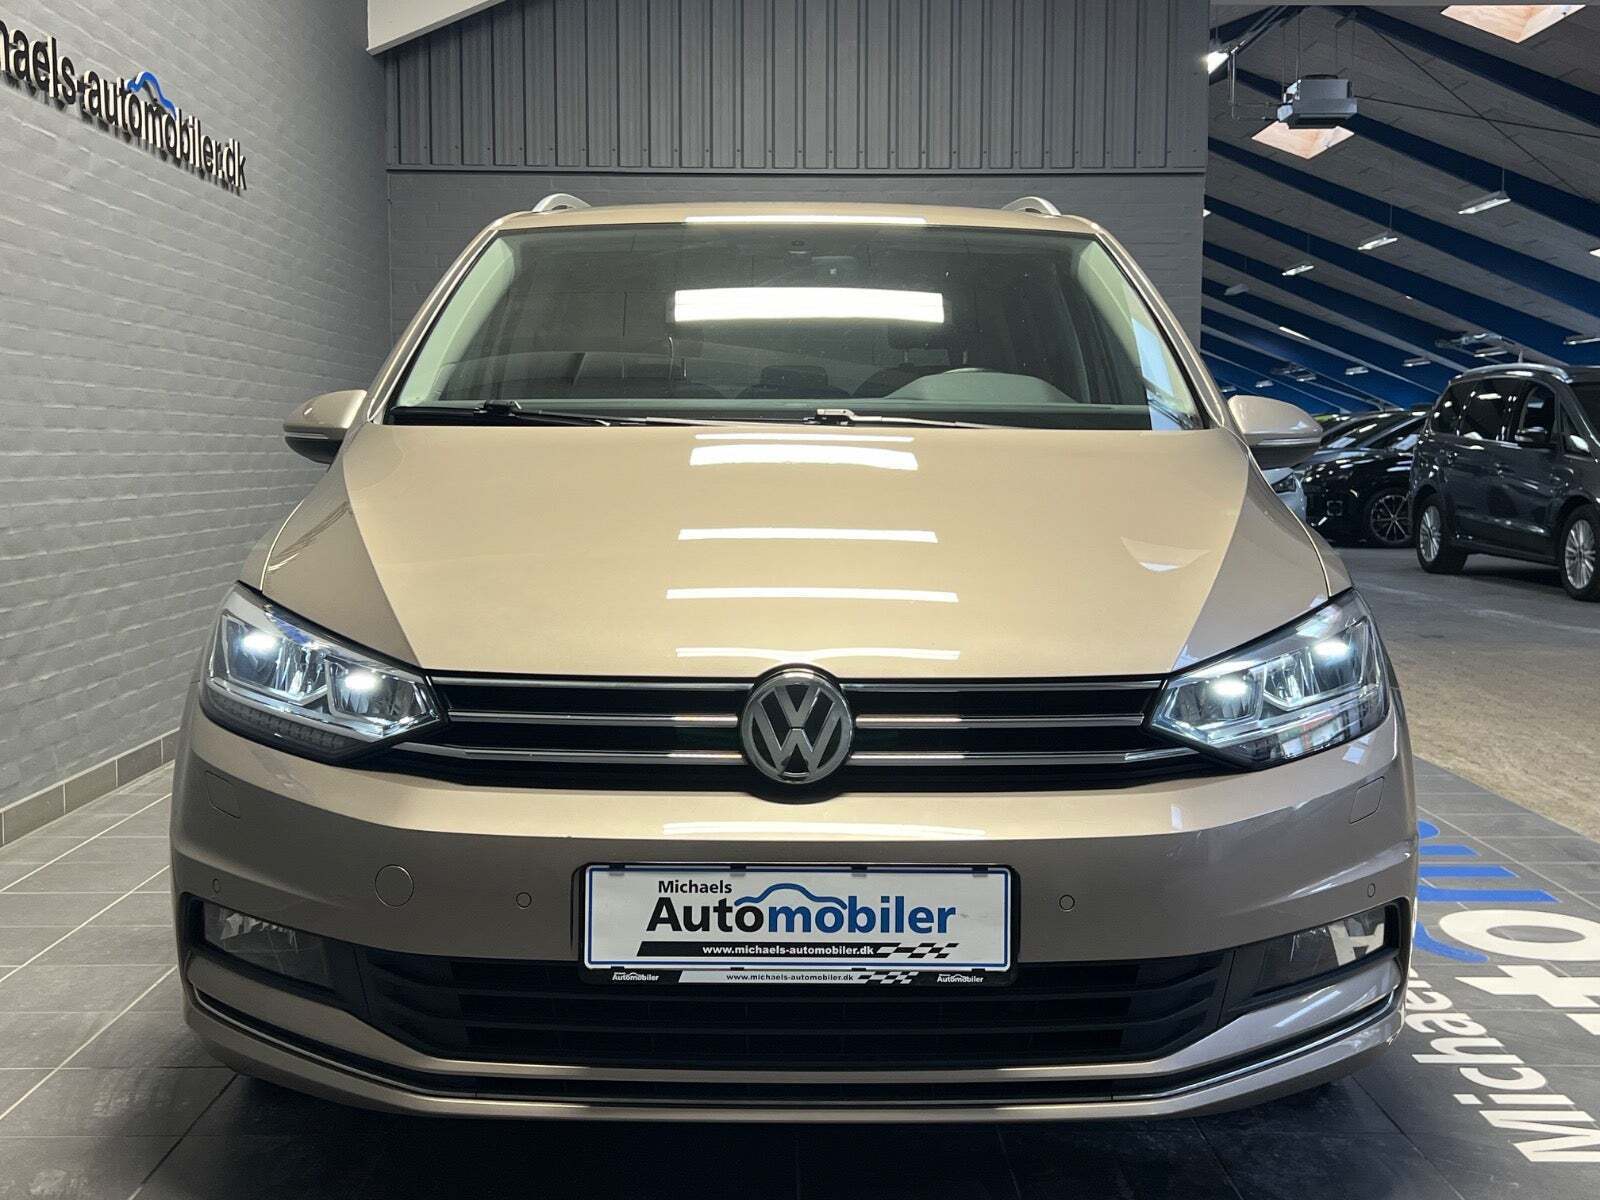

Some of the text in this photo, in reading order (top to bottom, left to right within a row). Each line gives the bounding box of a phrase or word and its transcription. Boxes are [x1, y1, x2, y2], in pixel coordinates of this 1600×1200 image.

[658, 880, 733, 894] Michaels
[646, 895, 957, 934] Automobiler
[702, 945, 875, 956] www.michaels-automobiler.dk
[726, 973, 854, 982] www.michaels-automobiler.dk
